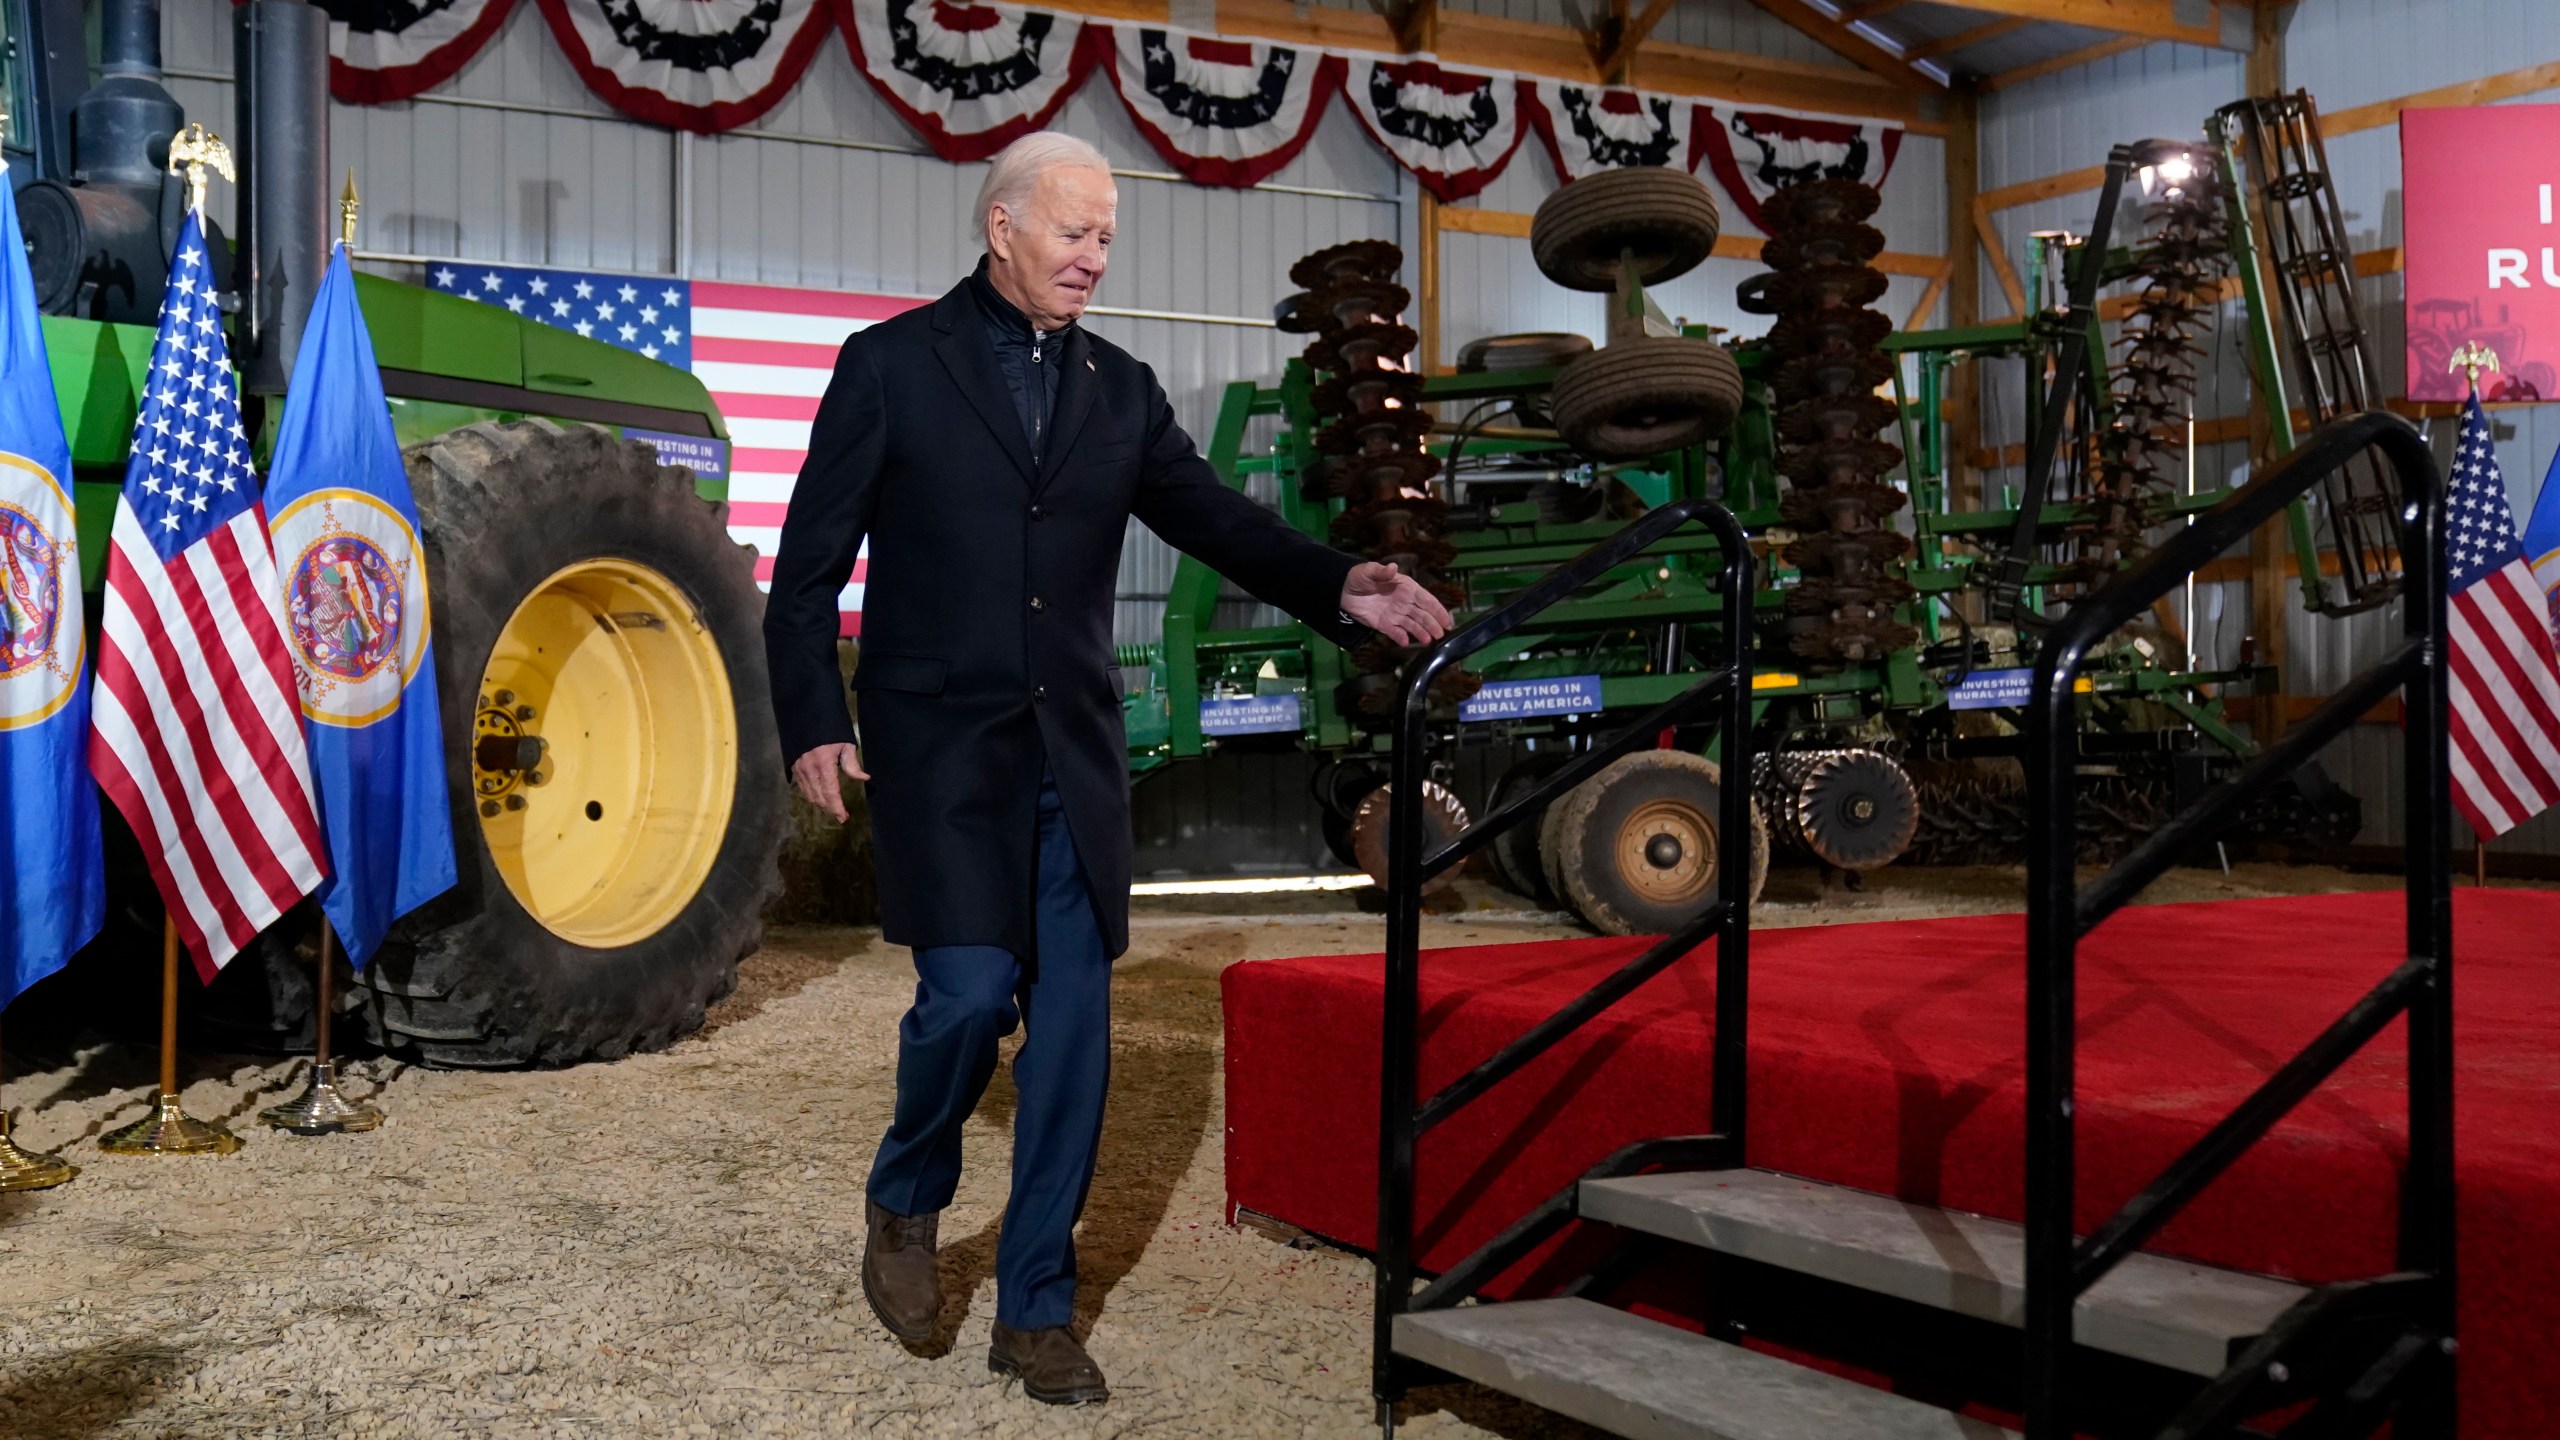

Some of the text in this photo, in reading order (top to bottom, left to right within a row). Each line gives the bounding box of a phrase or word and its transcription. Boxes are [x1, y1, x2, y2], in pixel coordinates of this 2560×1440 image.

[700, 445, 713, 457] IN
[380, 566, 396, 593] 1858
[1962, 678, 2028, 690] INVESTING
[1476, 682, 1581, 700] INVESTING IN
[1954, 690, 1995, 700] RURAL
[1204, 704, 1284, 718] INVESTING IN
[1467, 696, 1593, 715] RURAL AMERICA
[1239, 714, 1293, 726] AMERICA
